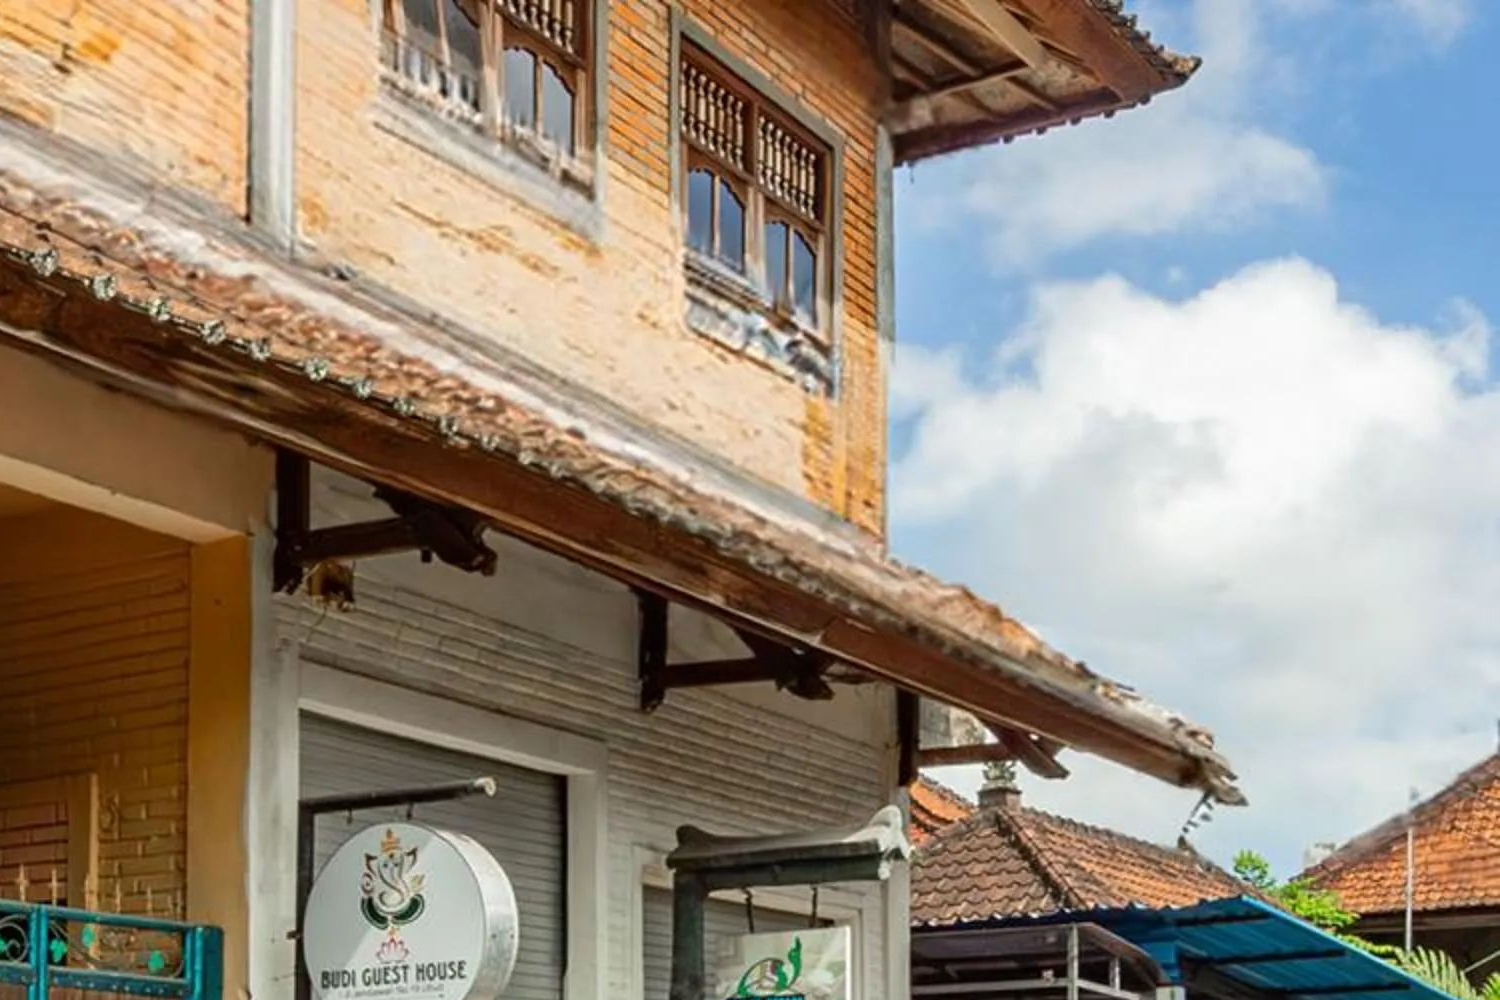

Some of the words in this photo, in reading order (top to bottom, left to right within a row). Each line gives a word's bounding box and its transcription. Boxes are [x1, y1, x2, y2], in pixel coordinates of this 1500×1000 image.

[321, 970, 357, 989] BUDI
[362, 965, 410, 986] GUEST
[415, 960, 467, 981] HOUSE
